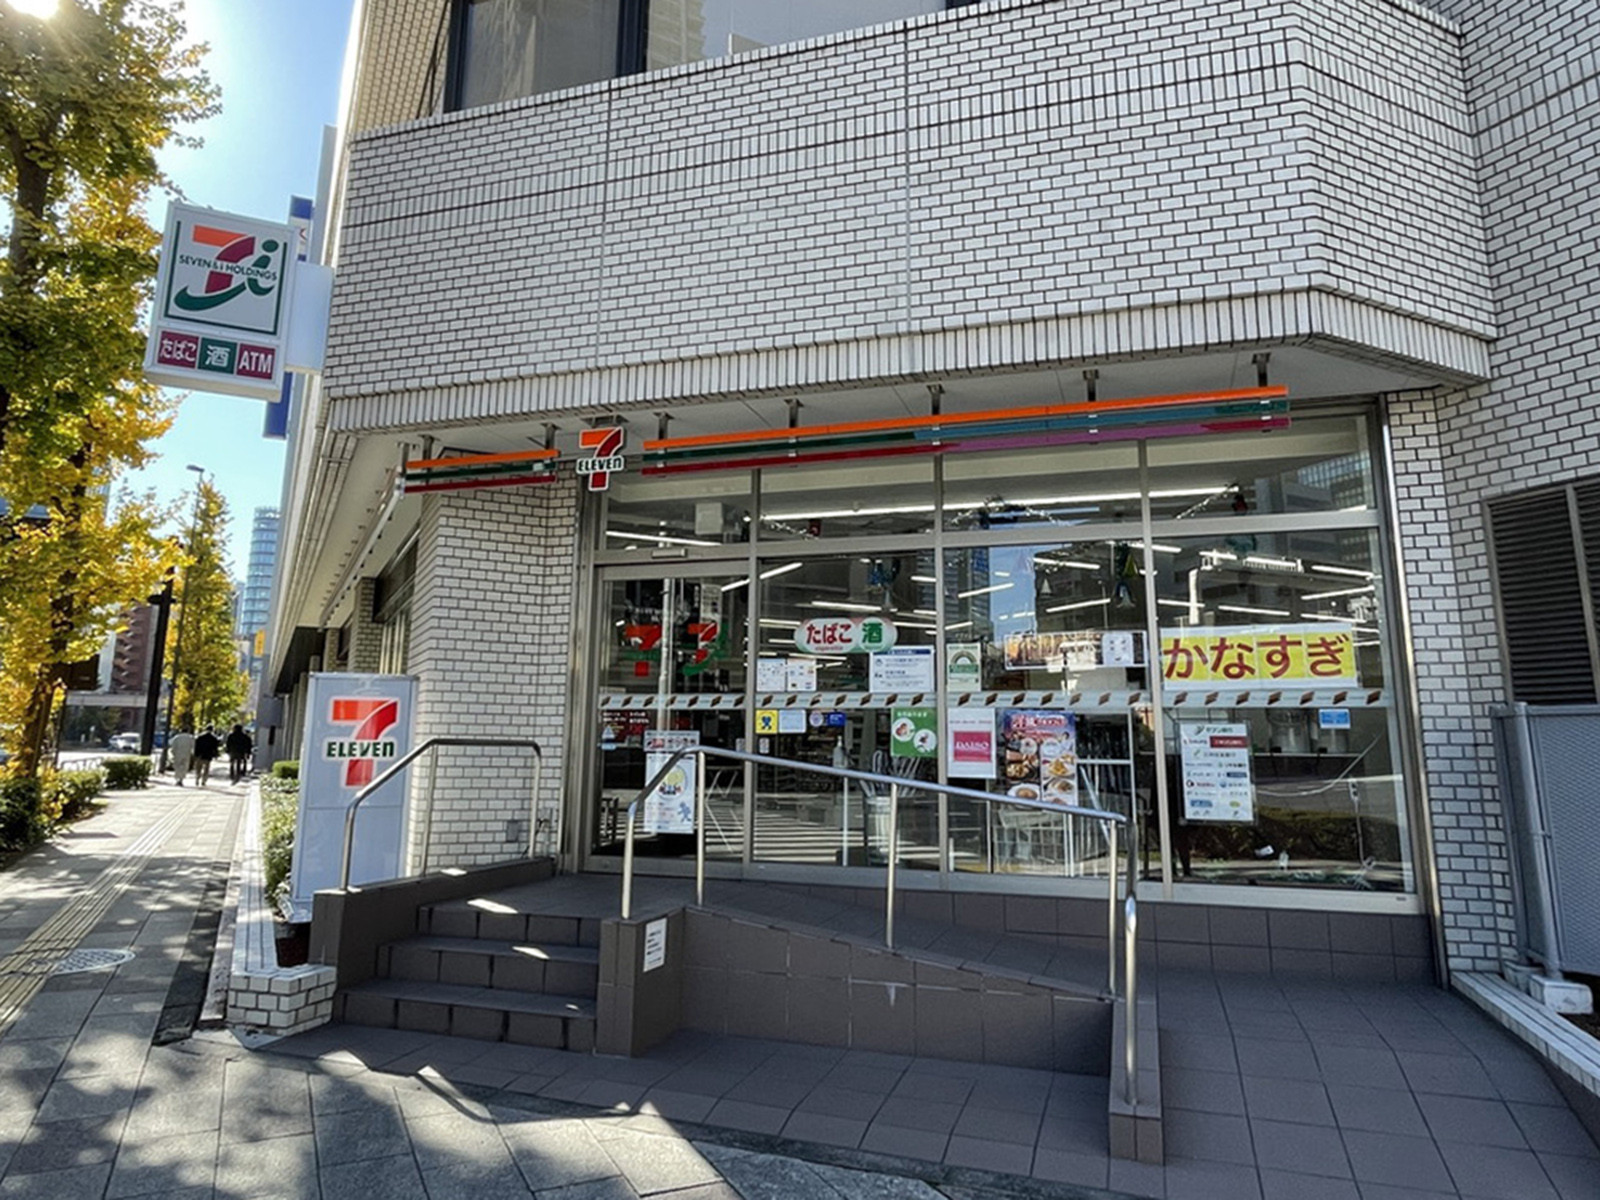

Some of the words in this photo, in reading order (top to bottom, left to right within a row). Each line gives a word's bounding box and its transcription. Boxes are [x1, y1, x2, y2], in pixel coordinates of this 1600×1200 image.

[179, 254, 211, 269] SEVEN
[225, 264, 277, 281] HOLDINGS
[160, 338, 196, 362] たばこ
[205, 345, 231, 367] 酒
[239, 350, 273, 373] ATM
[581, 428, 622, 488] 7
[806, 622, 852, 645] たばこ
[862, 622, 882, 644] 酒
[1163, 634, 1350, 679] かなすぎ
[332, 700, 397, 786] 7
